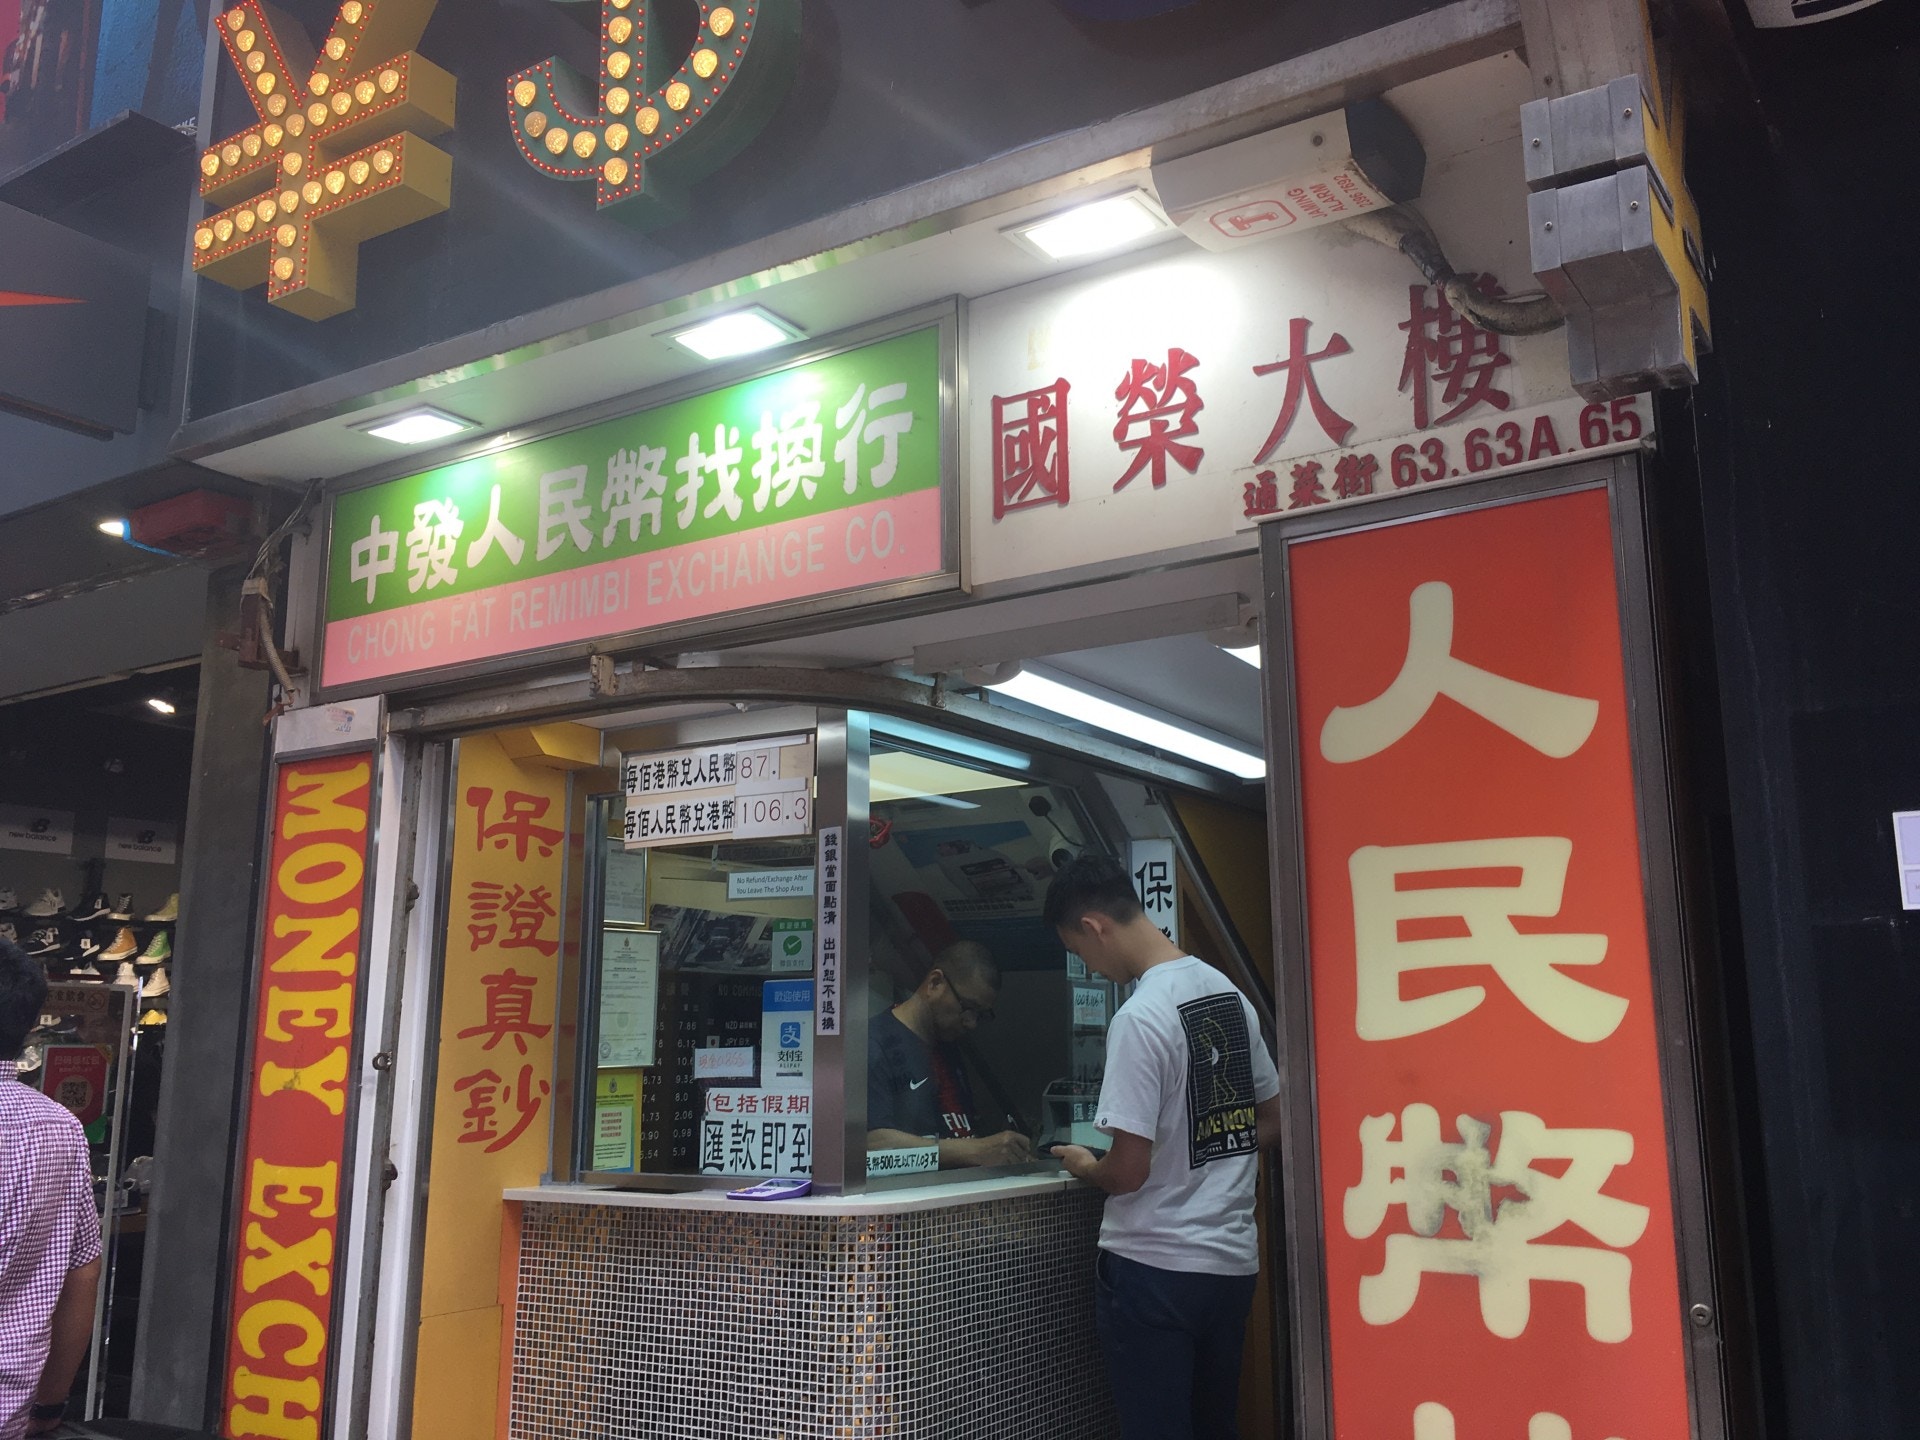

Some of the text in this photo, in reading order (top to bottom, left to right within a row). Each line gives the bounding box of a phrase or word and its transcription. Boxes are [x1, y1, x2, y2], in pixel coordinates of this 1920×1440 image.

[1309, 183, 1348, 212] ALARM
[990, 272, 1512, 521] 國榮大樓
[350, 382, 913, 605] 中發人民幣找換行
[1242, 453, 1379, 517] 通菜街
[347, 510, 905, 664] CHONG FAT REMIMBI EXCHANGE CO.
[25, 831, 57, 842] balance
[743, 797, 807, 824] 106.3
[736, 887, 746, 895] You
[747, 886, 763, 894] Leave
[775, 885, 789, 894] Shop
[745, 875, 793, 884] Refund/Exchange
[1134, 861, 1175, 944] 保
[454, 786, 565, 1154] 保證真鈔
[821, 937, 836, 1031] 出門恕不退換
[1320, 581, 1650, 1440] 人民幣
[777, 1050, 803, 1062] 支付宝
[224, 762, 371, 1440] MONEY EXCH
[942, 1112, 971, 1132] Fly
[703, 1118, 813, 1174] 匯款即到
